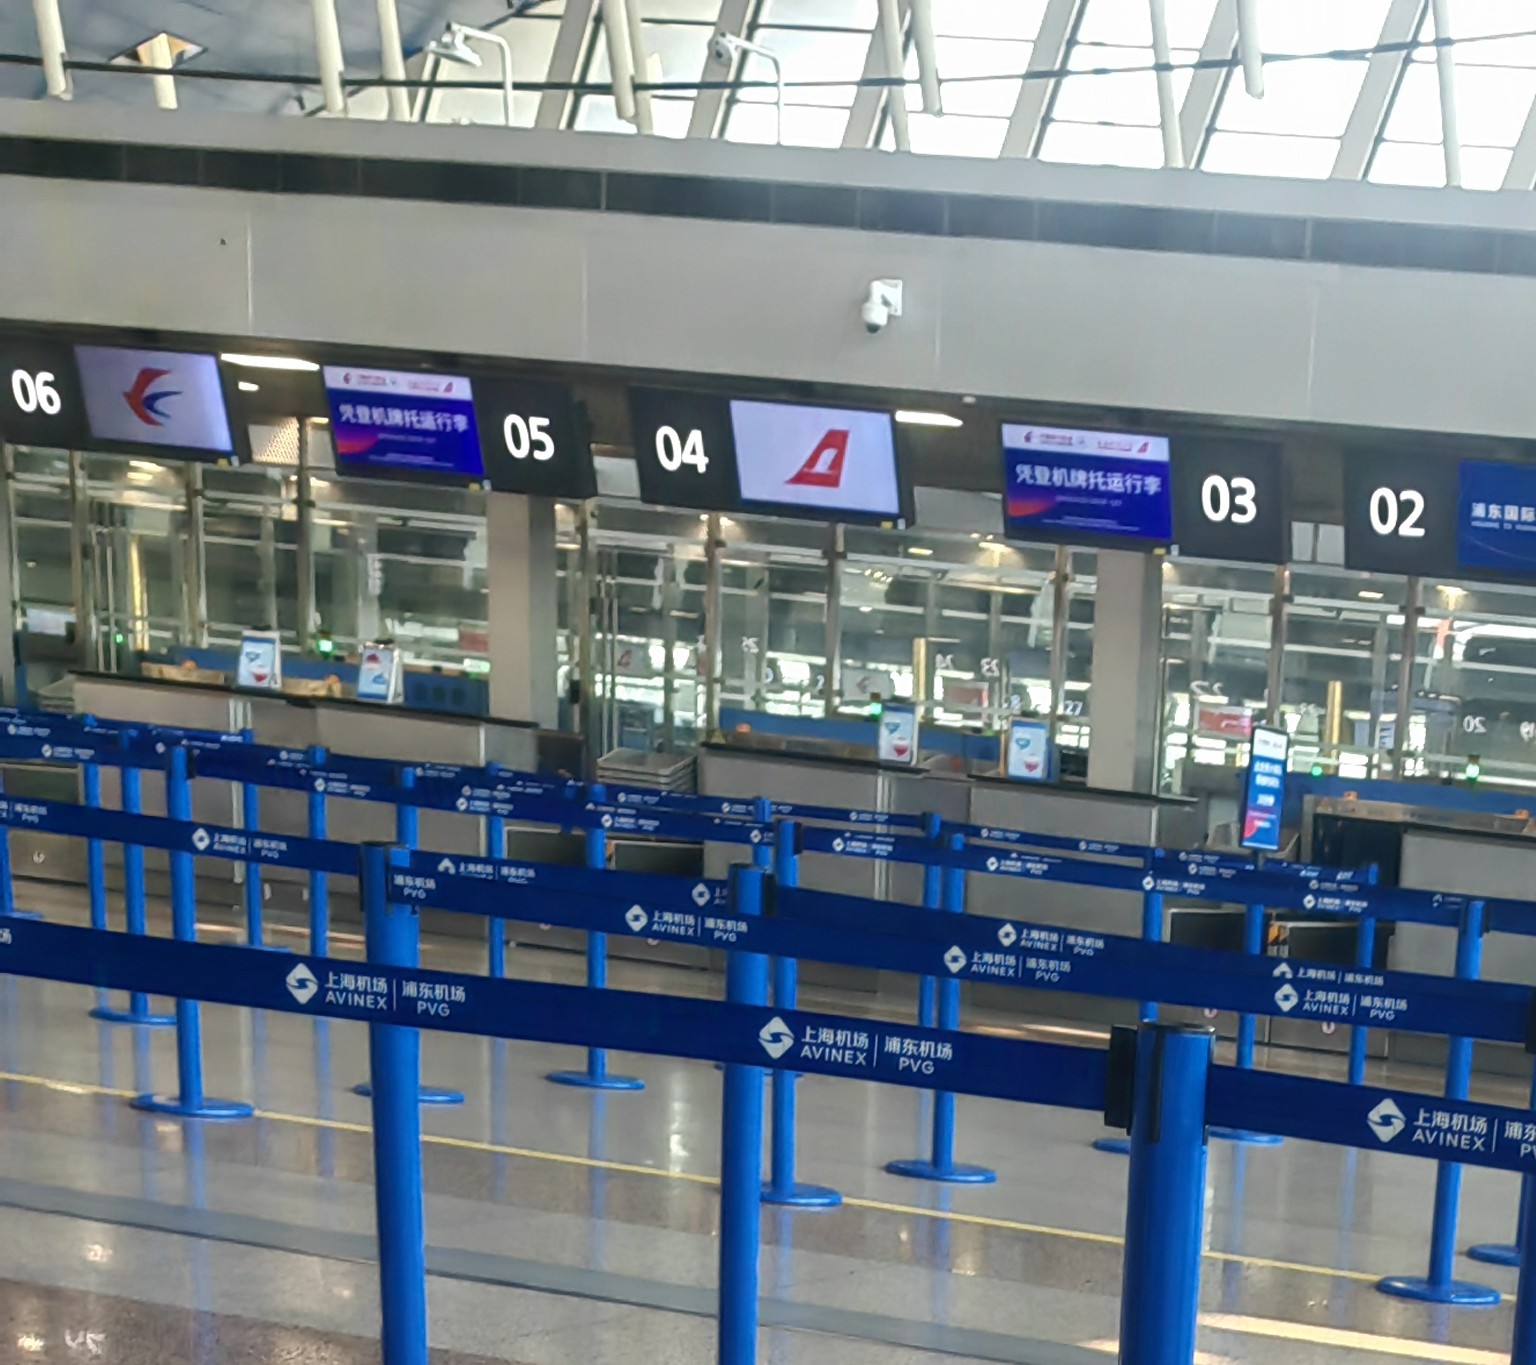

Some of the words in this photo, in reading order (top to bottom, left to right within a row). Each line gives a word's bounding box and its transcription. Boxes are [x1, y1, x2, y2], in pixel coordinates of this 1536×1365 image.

[12, 369, 61, 415] 06
[503, 414, 555, 461] 05
[655, 425, 709, 473] 04
[1201, 475, 1257, 523] 03
[1369, 487, 1426, 538] 02
[651, 923, 695, 936] AVINEX
[714, 930, 738, 943] PVG
[652, 910, 696, 927] 上海机场
[704, 917, 749, 933] 浦东机场
[971, 951, 1016, 966] 上海机场
[1025, 957, 1071, 973] 浦东机场
[971, 963, 1015, 978] AVINEX
[1035, 970, 1060, 983] PVG
[325, 970, 389, 995] 上海机场
[402, 980, 467, 1003] 浦东机场
[1304, 989, 1350, 1006] 上海机场
[1360, 996, 1408, 1012] 浦东机场
[325, 991, 388, 1011] AVINEX
[417, 1001, 451, 1018] PVG
[1303, 1002, 1348, 1016] AVINEX
[1370, 1008, 1396, 1021] PVG
[801, 1025, 870, 1050] 上海机场
[884, 1036, 954, 1061] 浦东机场
[800, 1045, 868, 1066] AVINEX
[899, 1056, 935, 1075] PVG
[1413, 1108, 1488, 1136] 上海机场
[1411, 1128, 1486, 1152] AVINEX
